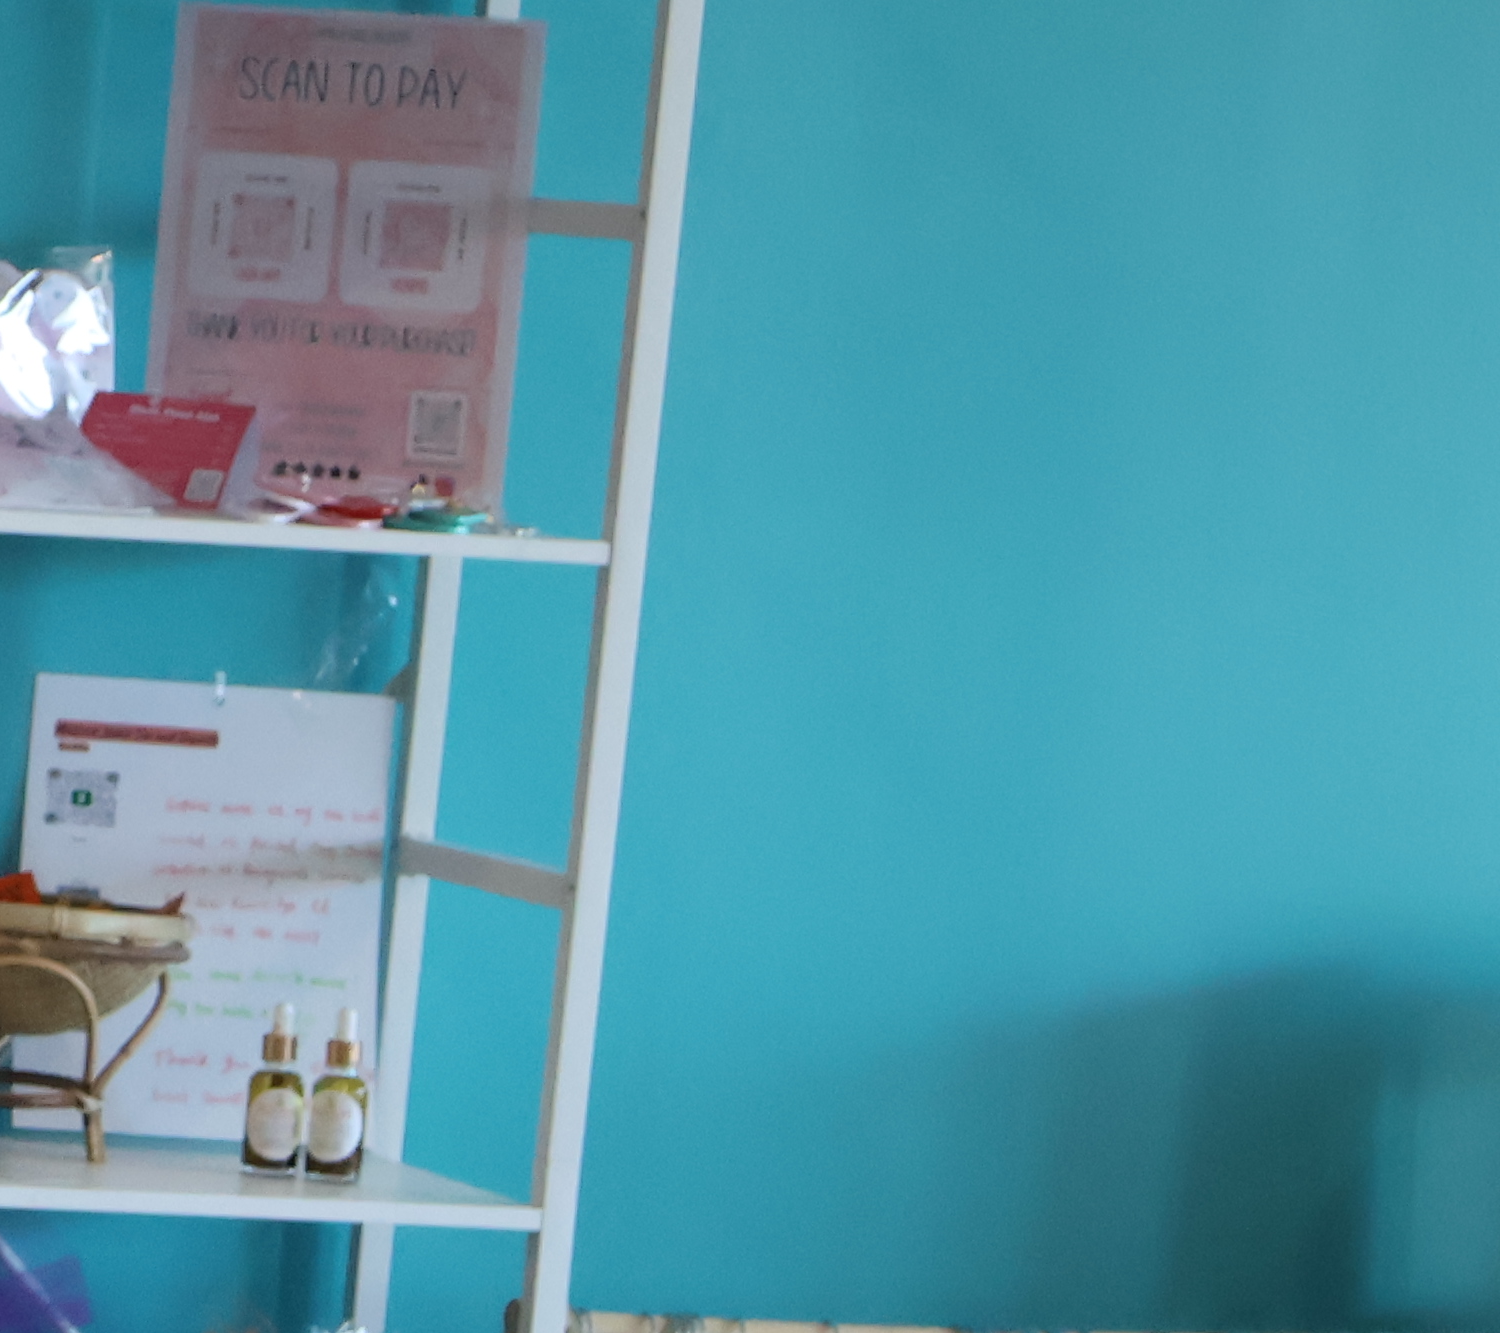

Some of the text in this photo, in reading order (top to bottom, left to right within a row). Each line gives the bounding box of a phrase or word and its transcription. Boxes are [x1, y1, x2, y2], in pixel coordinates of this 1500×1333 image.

[239, 56, 468, 109] SCAN TO PAY
